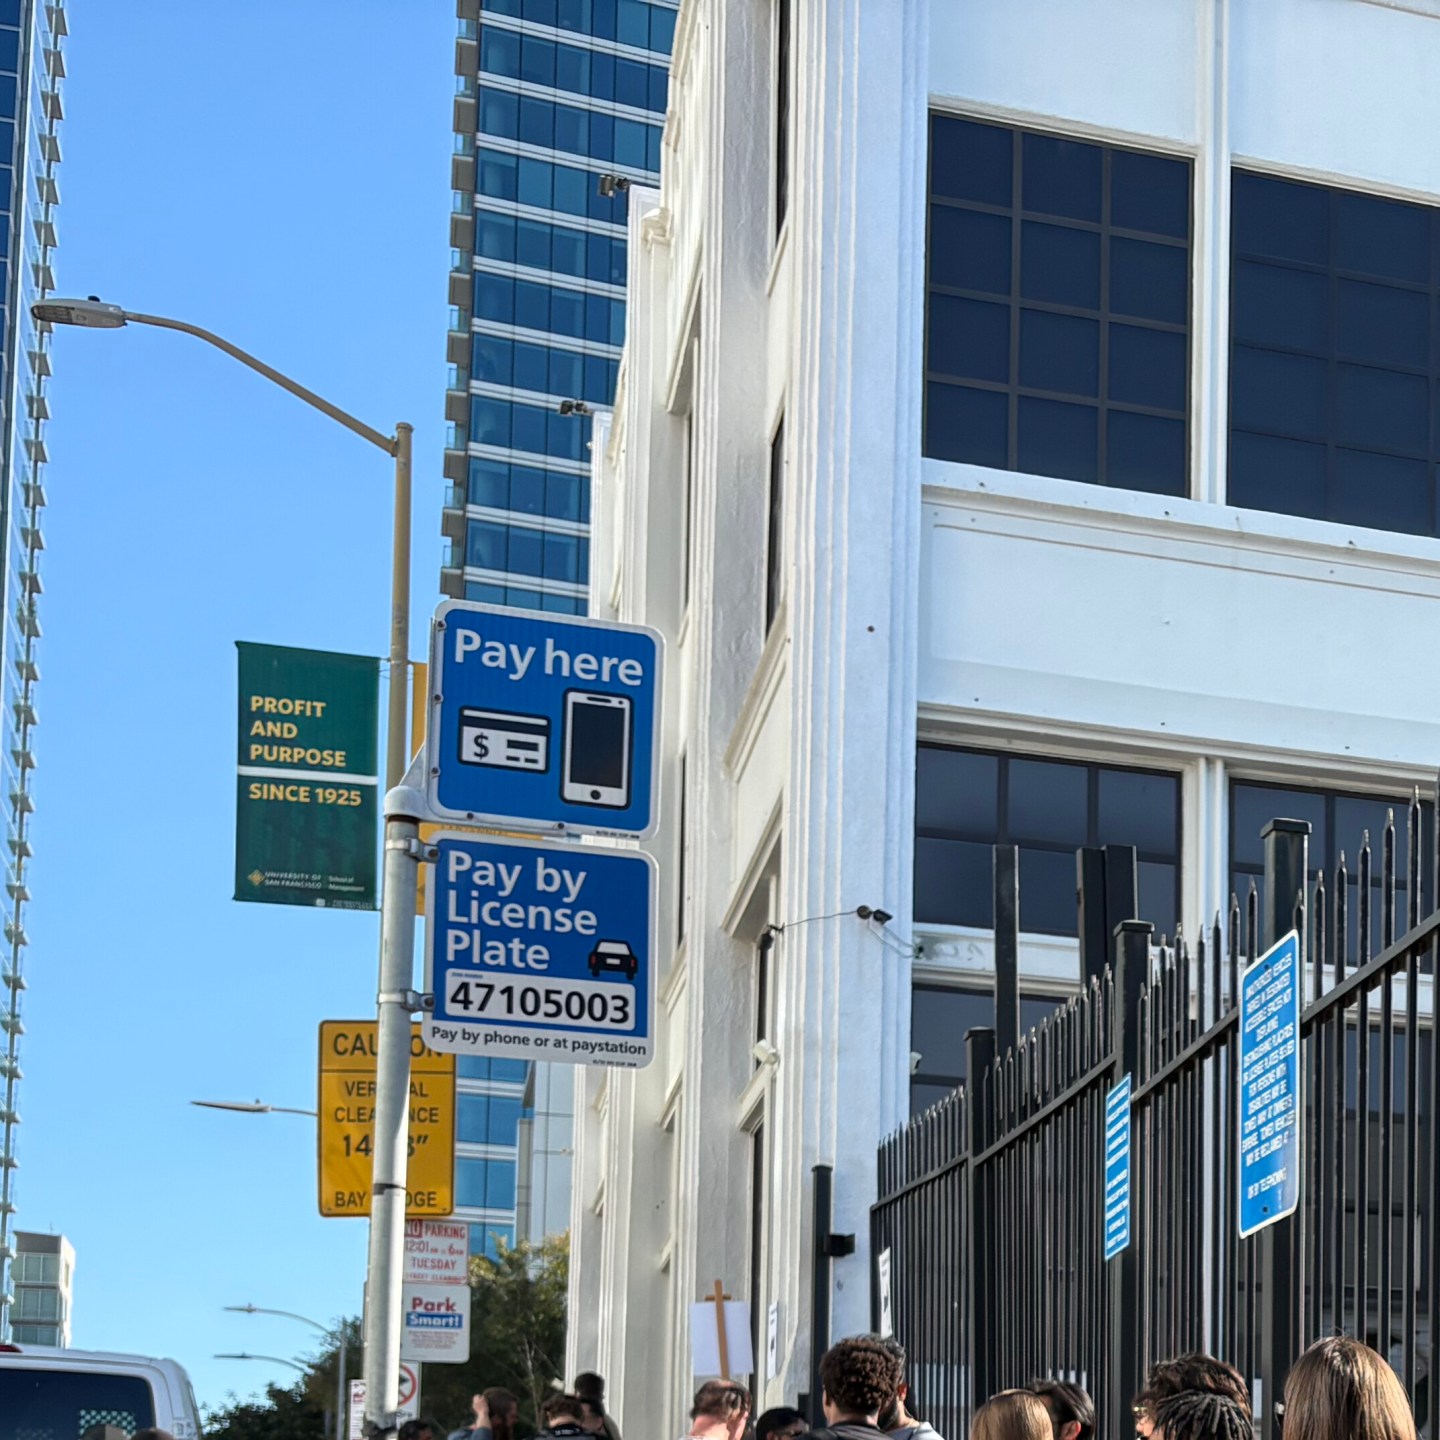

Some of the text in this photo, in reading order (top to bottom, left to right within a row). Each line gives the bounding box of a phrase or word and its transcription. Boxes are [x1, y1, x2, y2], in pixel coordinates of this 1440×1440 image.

[454, 629, 644, 686] Pay here
[250, 695, 326, 718] PROFIT
[250, 719, 298, 740] AND
[250, 744, 346, 768] PURPOSE
[249, 783, 361, 807] SINCE 1925
[448, 850, 587, 903] Pay by
[447, 889, 598, 936] License
[446, 929, 550, 971] Plate
[450, 982, 630, 1025] 47105003
[432, 1026, 647, 1057] Pay by phone or at paystation
[345, 1081, 429, 1097] VERAL
[335, 1191, 367, 1207] BAY
[425, 1223, 465, 1240] PARKING
[412, 1256, 457, 1270] TUESDAY
[412, 1296, 456, 1312] Park
[410, 1312, 459, 1327] Smart!
